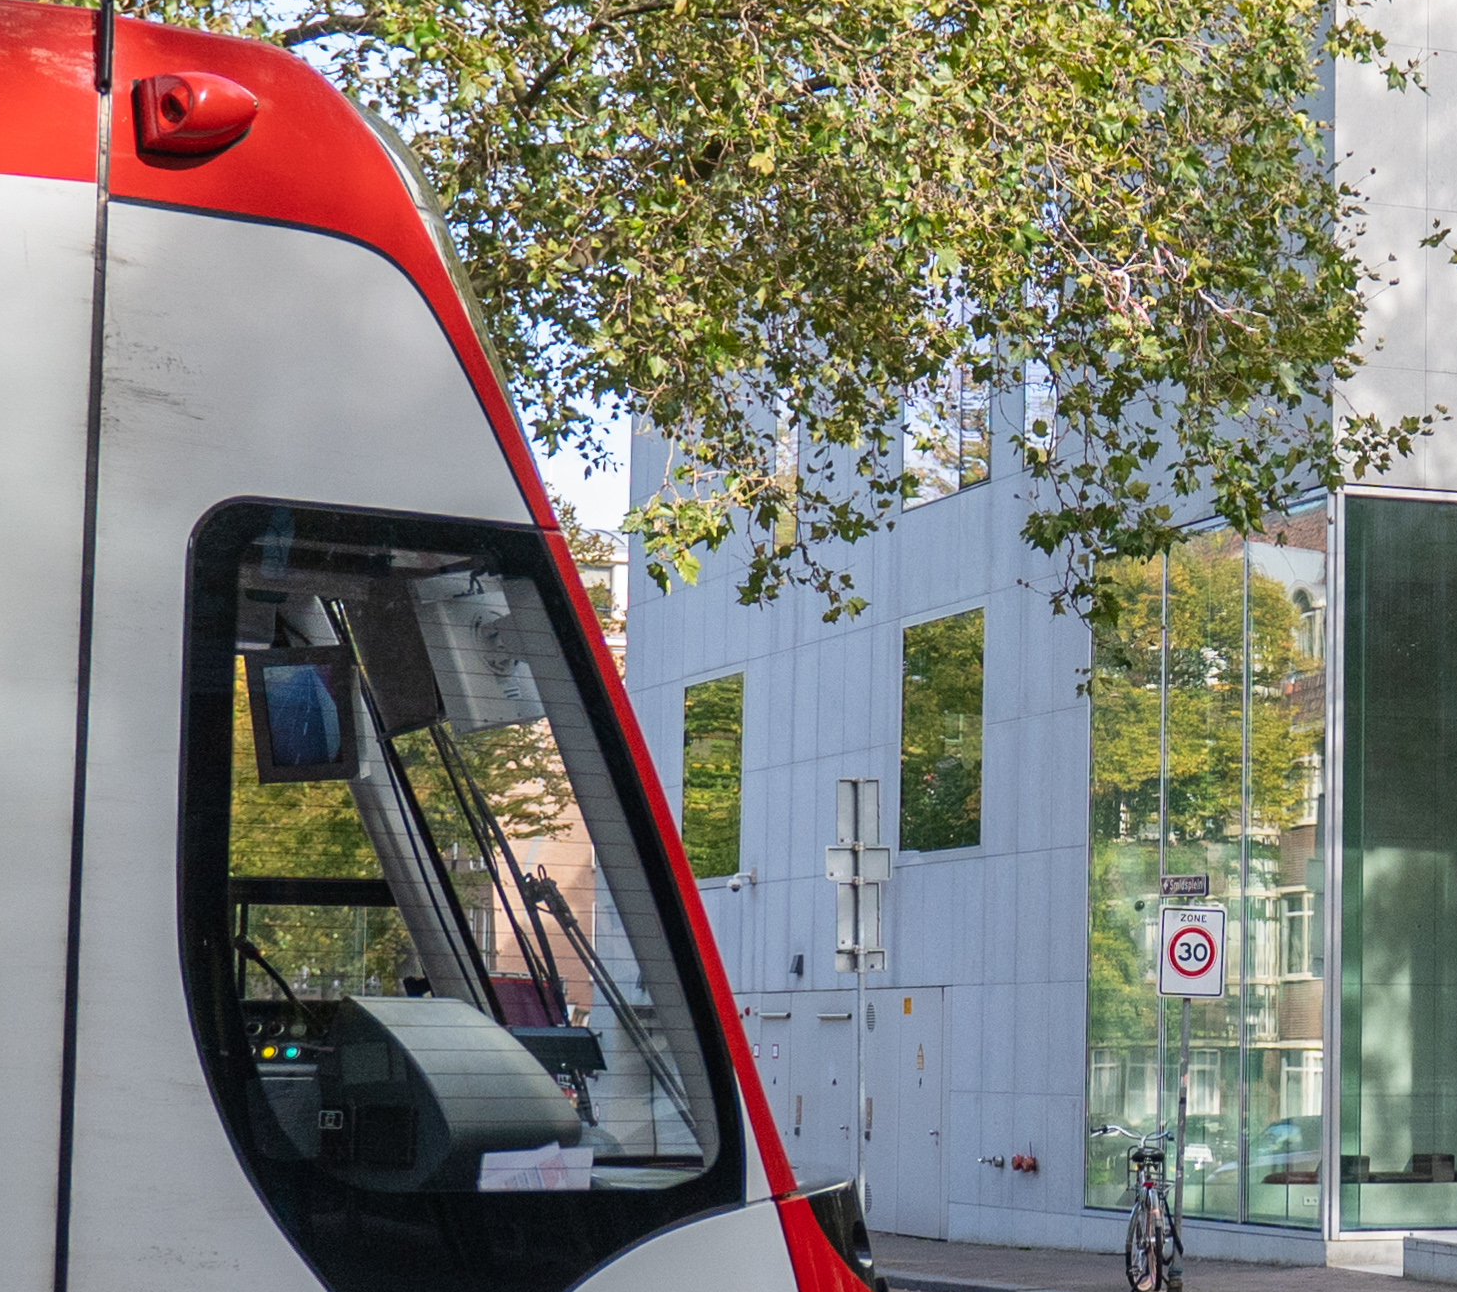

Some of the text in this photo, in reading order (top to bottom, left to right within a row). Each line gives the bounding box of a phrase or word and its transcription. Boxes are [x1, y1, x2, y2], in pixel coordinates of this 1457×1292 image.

[1169, 879, 1204, 893] Smidsplein
[1180, 913, 1207, 923] ZONE
[1177, 942, 1208, 962] 30
